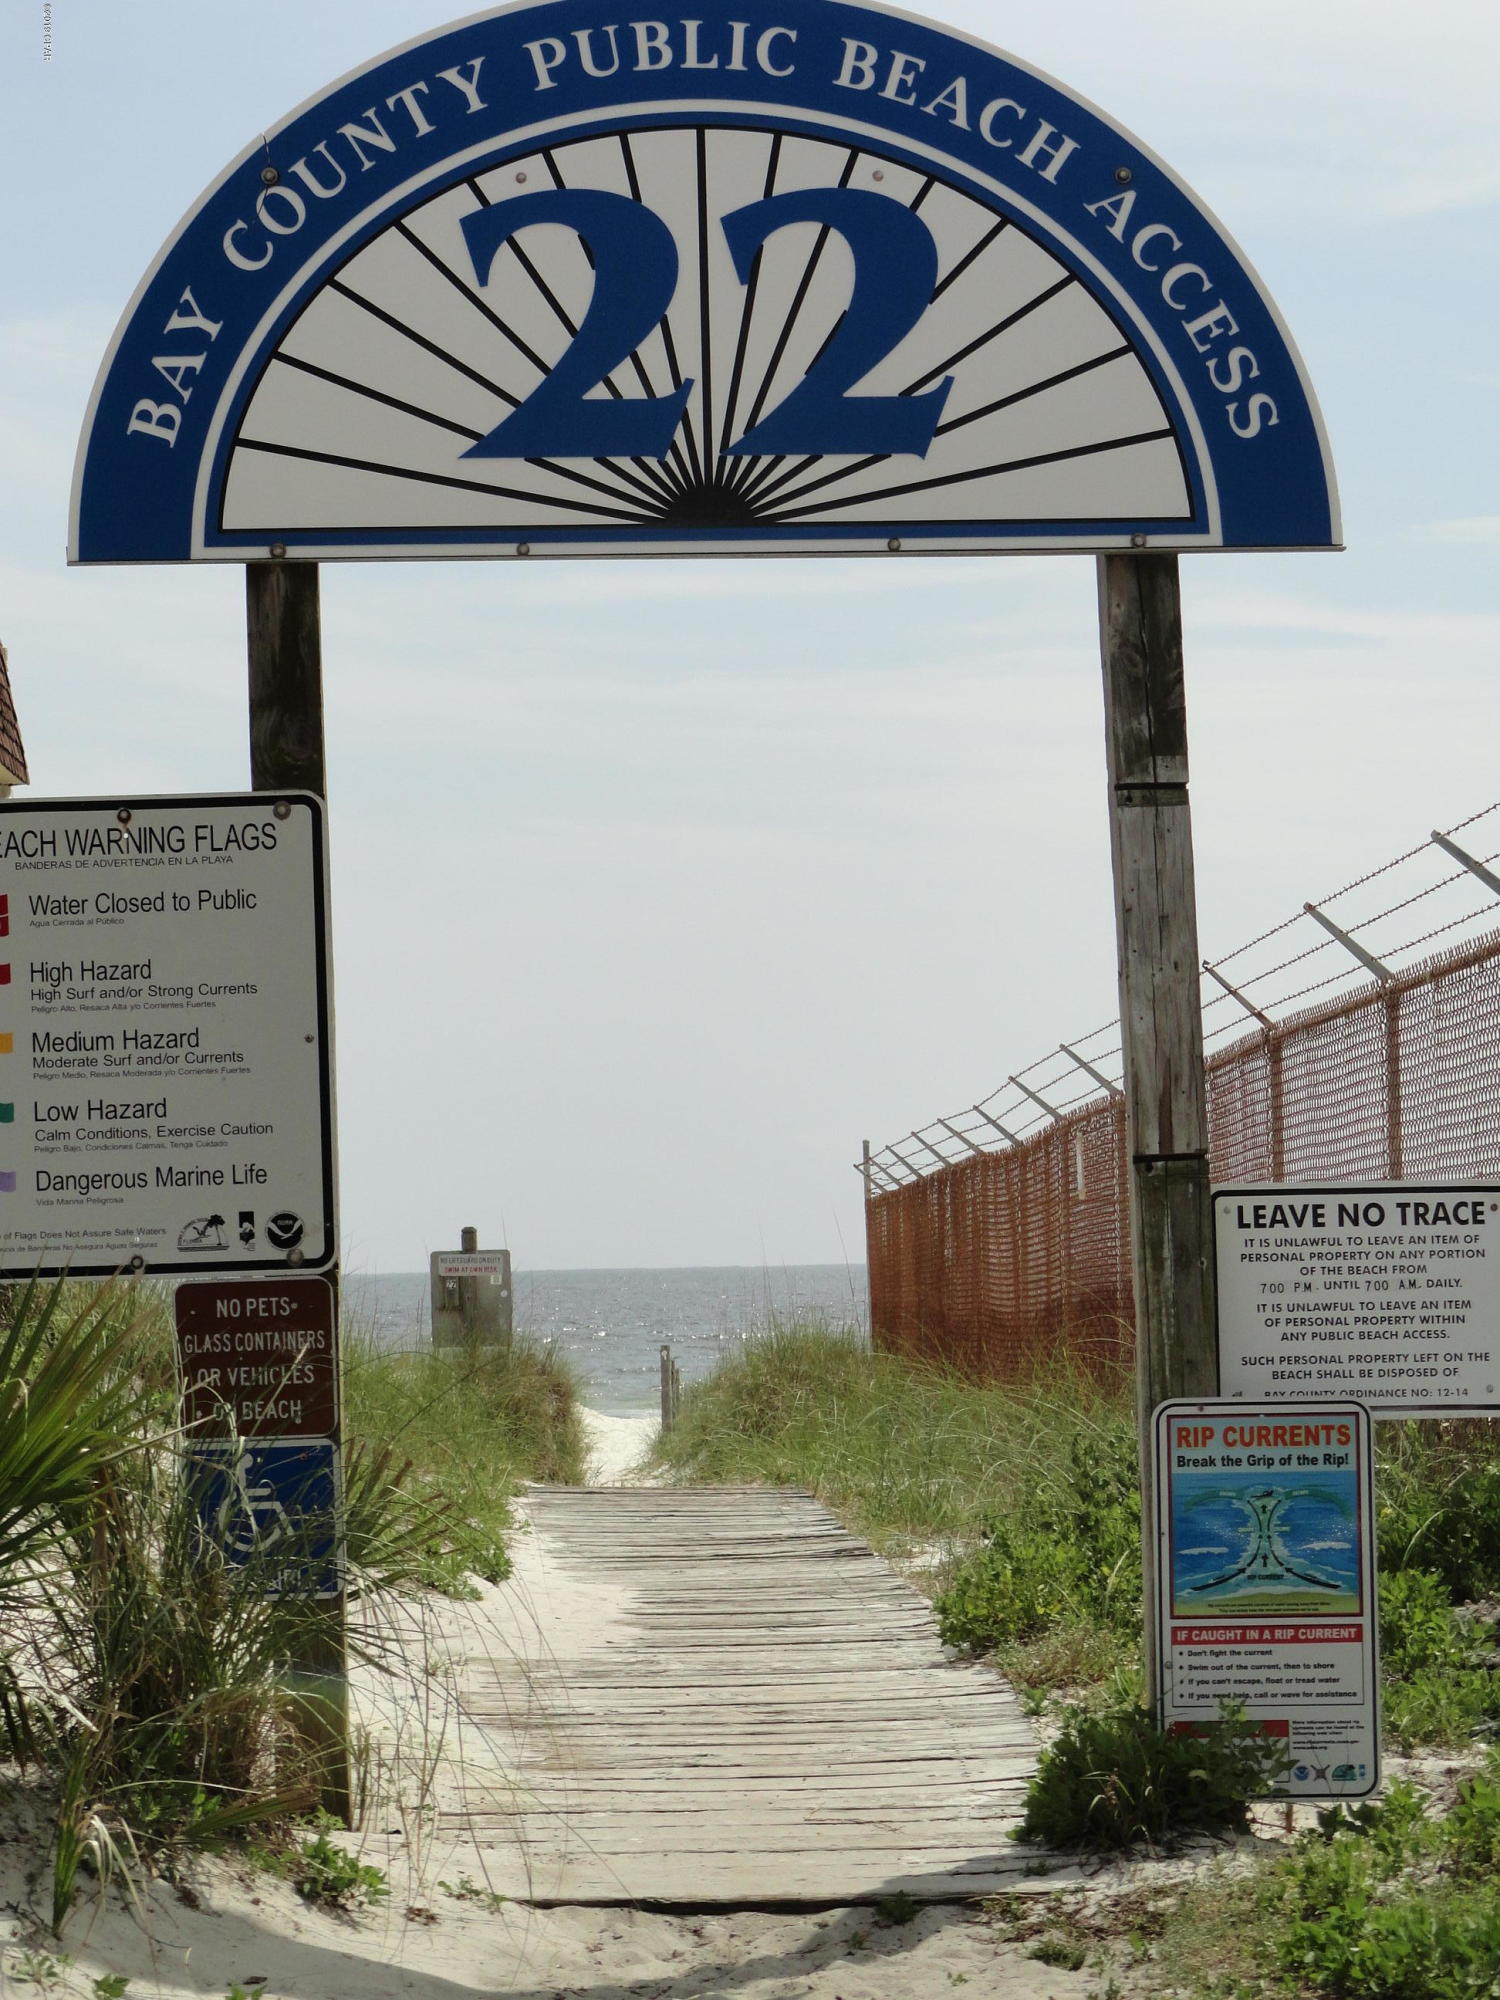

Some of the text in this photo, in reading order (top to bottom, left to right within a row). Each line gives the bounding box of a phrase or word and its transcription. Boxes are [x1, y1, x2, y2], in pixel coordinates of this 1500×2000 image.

[126, 20, 1280, 449] BAY COUNTY PUBLIC BEACH ACCESS
[459, 187, 955, 462] 22
[0, 822, 277, 858] ACH WARNING FLAGS
[14, 855, 234, 871] BANDERAS DE ADVERTENCIA EN LA PLAYA
[29, 888, 257, 916] Water Closed to Public
[31, 959, 151, 987] High Hazard
[31, 982, 258, 1004] High Surf and/or Strong Currents
[32, 1027, 199, 1054] Medium Hazard
[33, 1051, 244, 1069] Moderate Surf and/or Currents
[34, 1097, 167, 1122] Low Hazard
[35, 1122, 273, 1142] Calm Conditions, Exercise Caution
[36, 1163, 267, 1196] Dangerous Marine Life
[1237, 1201, 1485, 1230] LEAVE NO TRACE
[3, 1227, 167, 1242] of Flags Does Not Assure Safe Waters
[1244, 1234, 1479, 1248] IT IS UNLAWFUL TO LEAVE AN ITEM OF
[1240, 1248, 1485, 1263] PERSONAL PROPERTY ON ANY PORTION
[1300, 1264, 1427, 1276] OF THE BEACH FROM
[1324, 1280, 1360, 1291] UNTIL
[216, 1296, 290, 1319] NO PETS
[1257, 1299, 1471, 1314] IT IS UNLAWFUL TO LEAVE AN ITEM
[1264, 1314, 1465, 1328] OF PERSONAL PROPERTY WITHIN
[184, 1331, 325, 1354] GLASS CONTAINERS
[1280, 1329, 1450, 1342] ANY PUBLIC BEACH ACCESS.
[1241, 1352, 1490, 1367] SUCH PERSONAL PROPERTY LEFT ON THE
[1272, 1370, 1312, 1381] BEACH
[1316, 1369, 1355, 1380] SHALL
[1359, 1368, 1373, 1379] BE
[1378, 1367, 1438, 1378] DISPOSED
[1411, 1388, 1432, 1398] NO:
[1438, 1388, 1468, 1397] 12-14
[244, 1401, 301, 1420] BEACH
[1177, 1425, 1351, 1448] RIP CURRENTS
[1177, 1452, 1349, 1470] Break the Grip of the Rip!
[1177, 1628, 1357, 1642] IF CAUGHT IN A RIP CURRENT
[1209, 1649, 1227, 1659] fight
[1188, 1664, 1209, 1672] Swim
[1226, 1663, 1233, 1671] of
[1236, 1663, 1248, 1671] the
[1250, 1663, 1281, 1671] current,
[1313, 1662, 1335, 1670] shore
